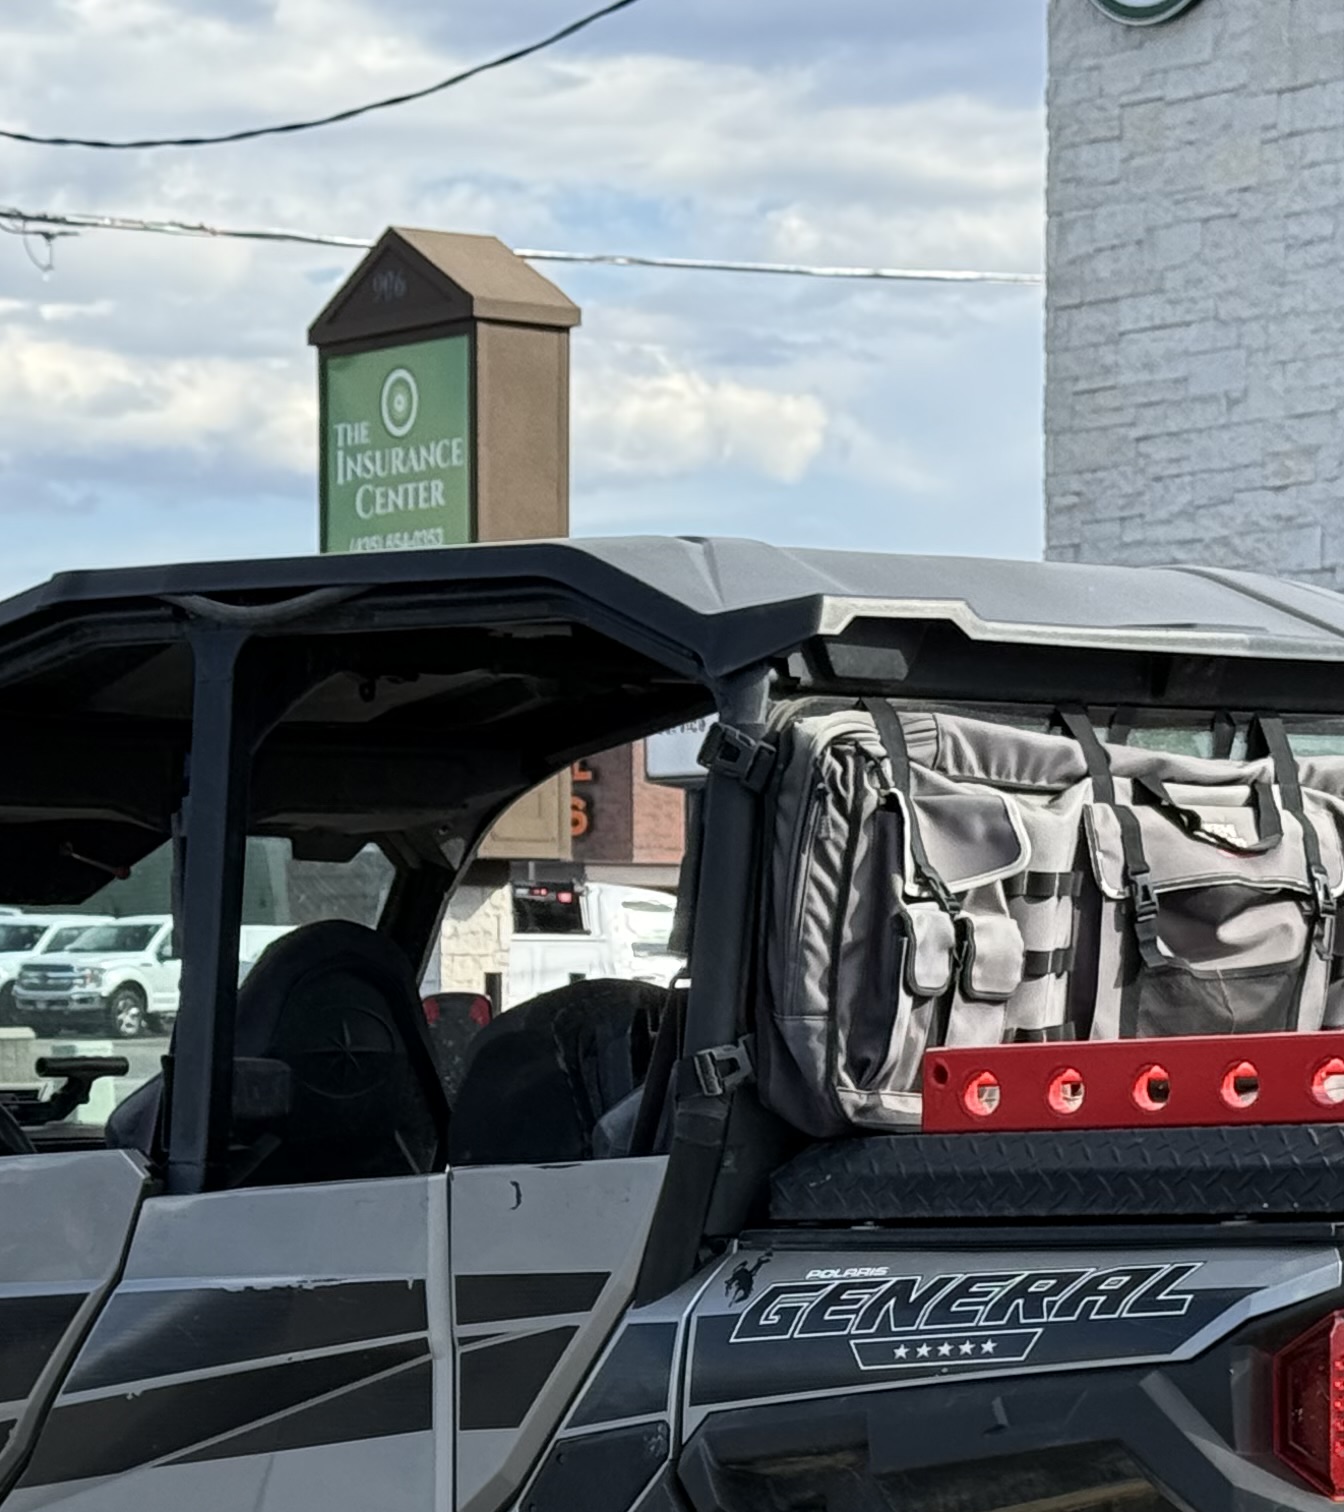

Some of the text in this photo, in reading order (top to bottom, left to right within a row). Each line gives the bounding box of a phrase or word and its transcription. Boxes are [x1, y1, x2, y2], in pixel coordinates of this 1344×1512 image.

[334, 421, 370, 447] THE
[337, 437, 465, 485] INSURANCE
[355, 479, 445, 519] CENTER
[806, 1266, 891, 1280] POLARIS
[729, 1262, 1206, 1343] GENERAL
